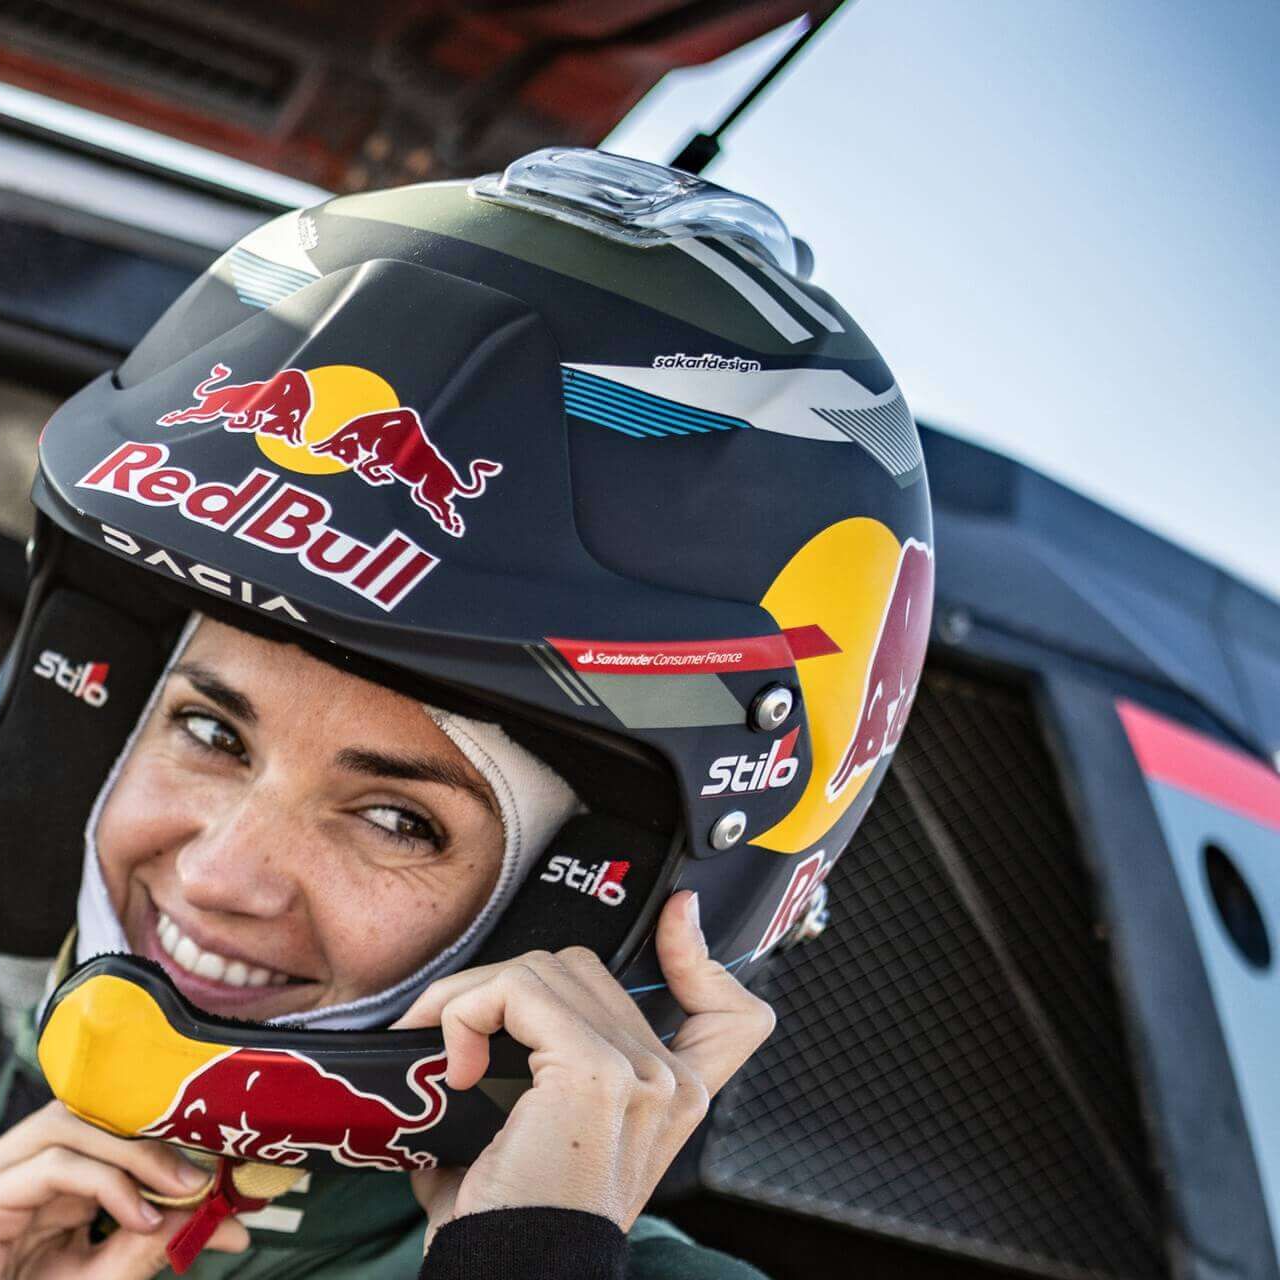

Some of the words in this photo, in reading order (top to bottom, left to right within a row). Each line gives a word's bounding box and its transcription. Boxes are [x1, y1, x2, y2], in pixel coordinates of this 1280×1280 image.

[75, 441, 279, 532] Red
[233, 482, 440, 612] Bull
[101, 523, 308, 623] DACIA
[33, 649, 109, 708] Stilo
[593, 652, 654, 666] Santander
[653, 652, 707, 666] Consumer
[705, 651, 743, 664] Finance
[701, 731, 801, 797] Stilo
[540, 855, 630, 906] Stilo
